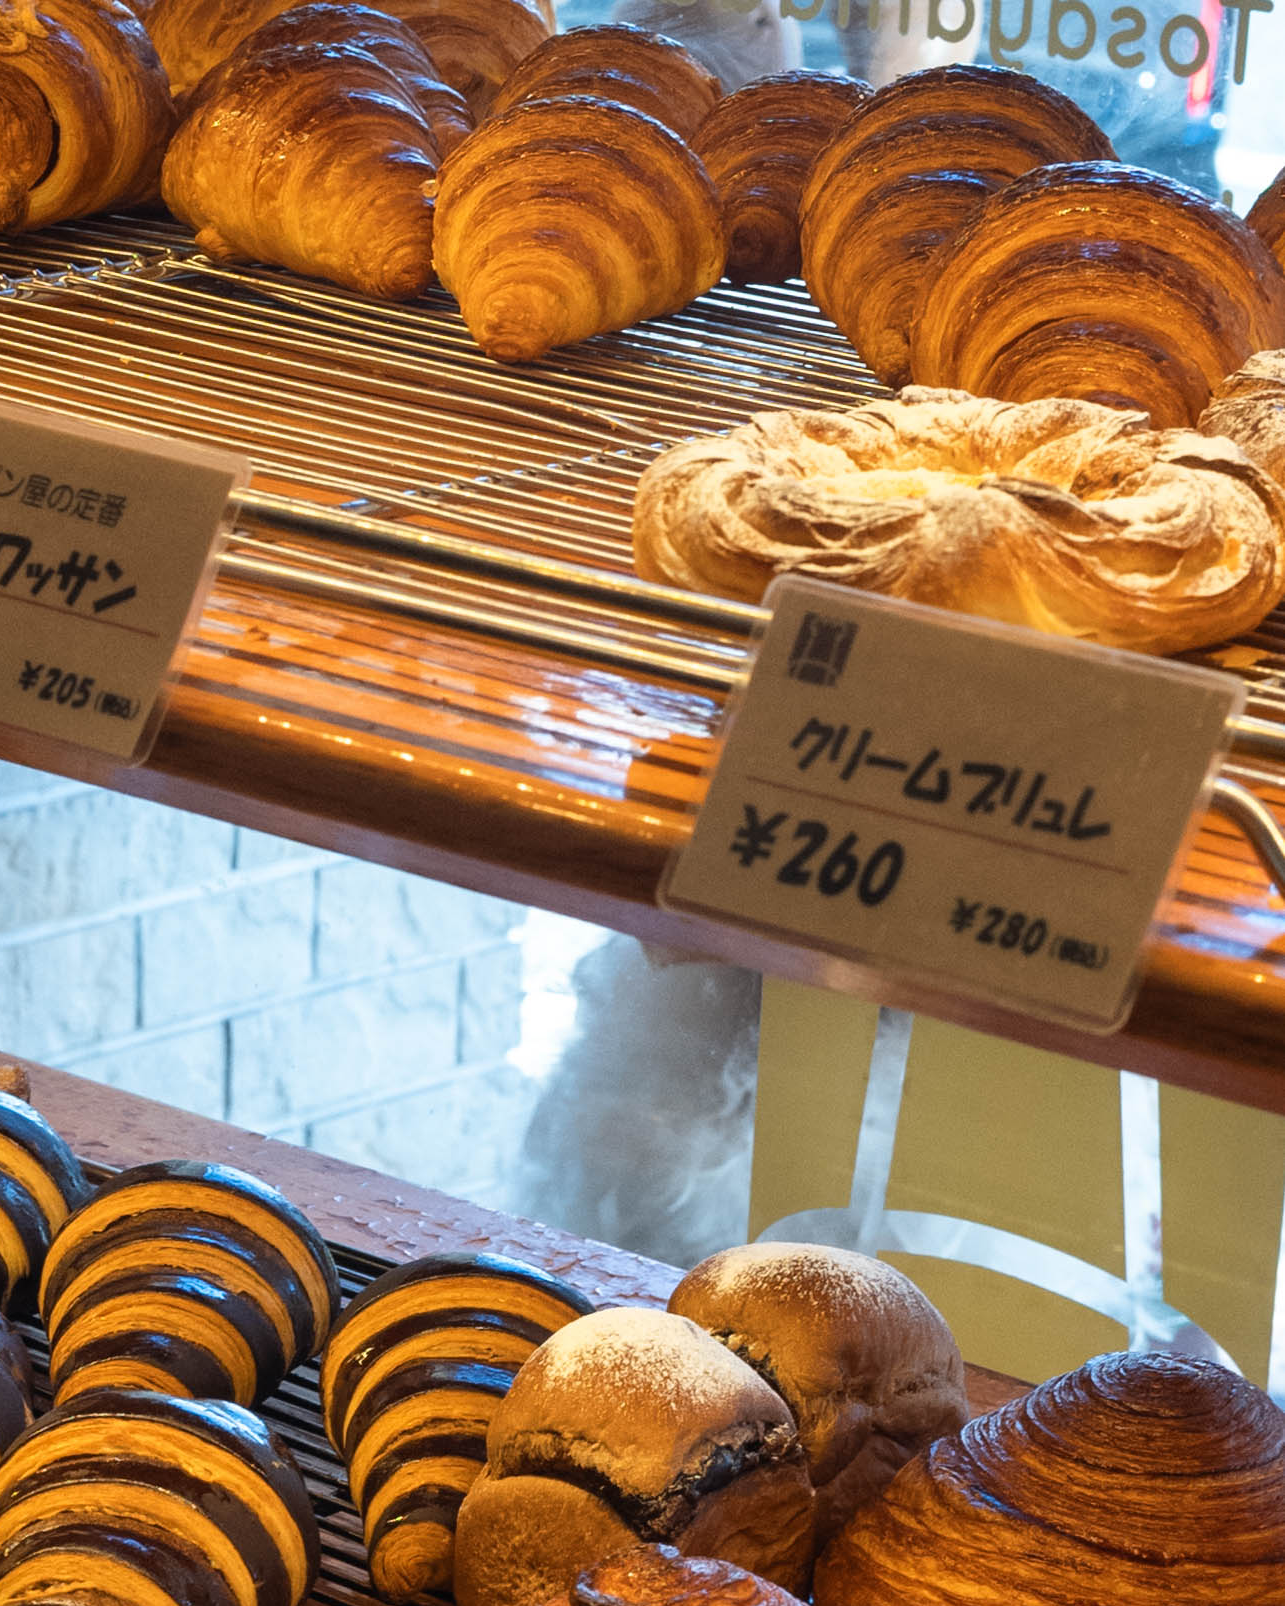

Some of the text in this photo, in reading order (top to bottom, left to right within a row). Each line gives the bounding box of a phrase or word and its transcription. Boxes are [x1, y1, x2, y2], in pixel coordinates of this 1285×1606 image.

[790, 718, 1111, 843] クリームブリュレ
[729, 803, 905, 906] ¥260
